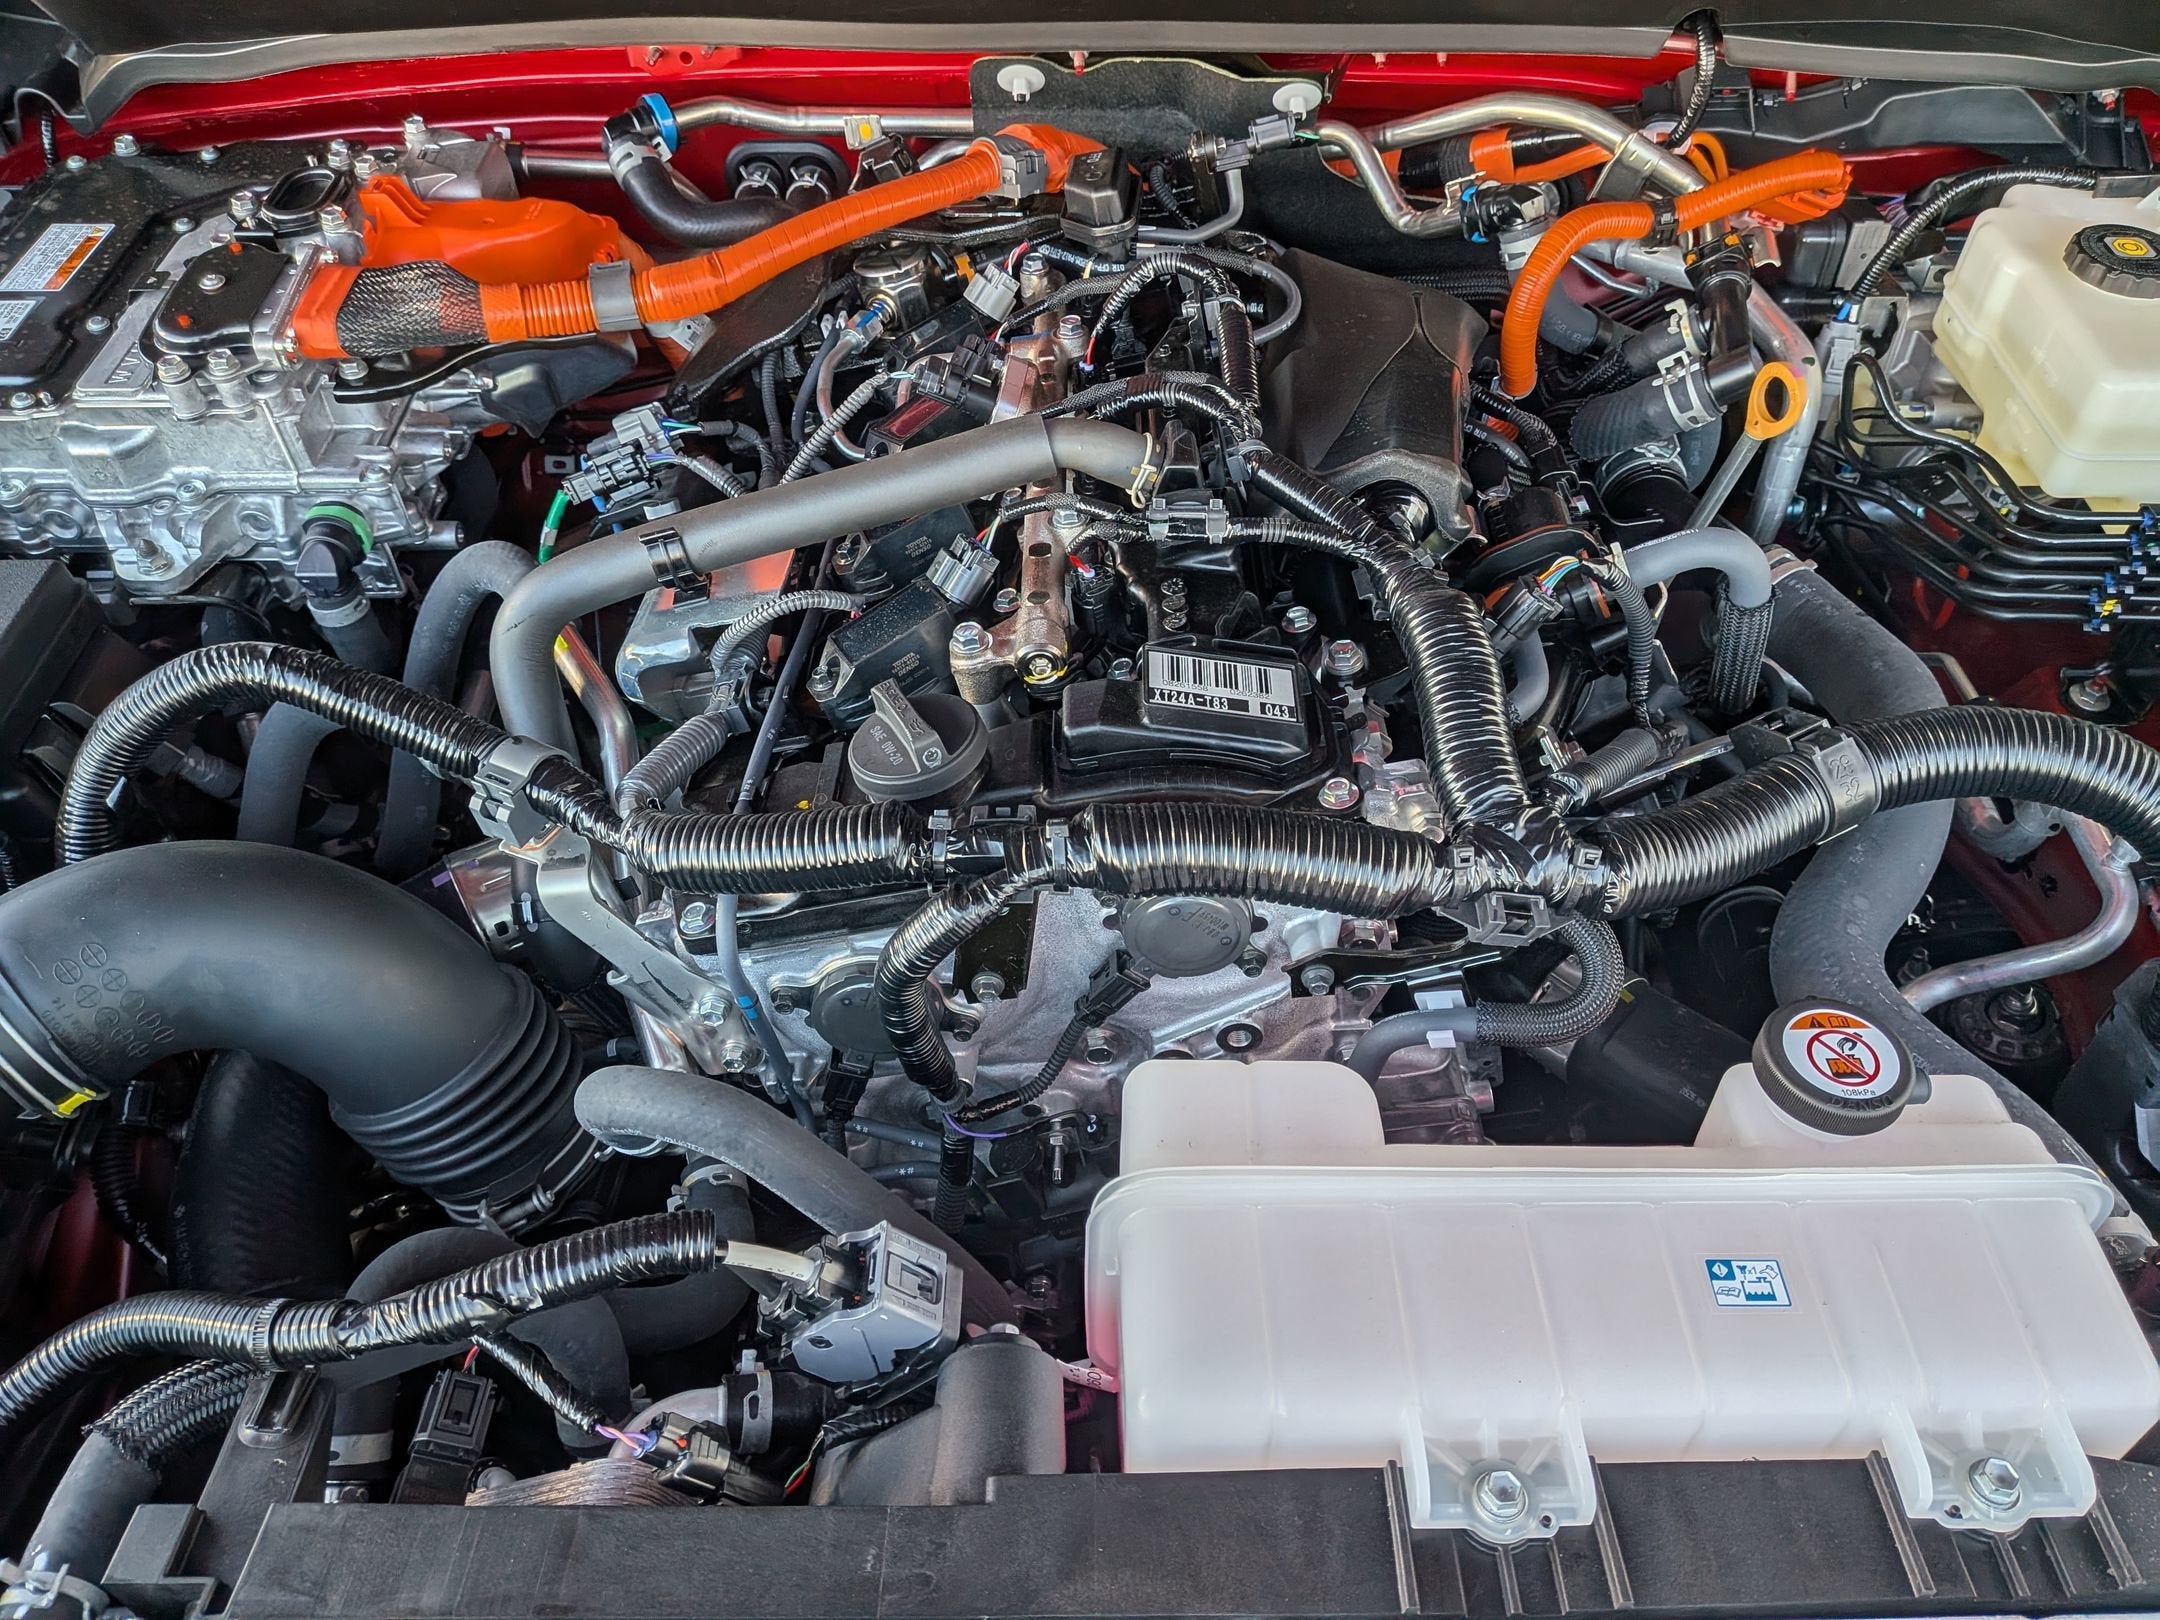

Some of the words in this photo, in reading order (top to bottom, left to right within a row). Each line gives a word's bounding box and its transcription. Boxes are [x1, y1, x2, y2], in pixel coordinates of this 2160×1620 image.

[892, 652, 916, 668] TOYOTA
[897, 660, 920, 677] DENSO
[1153, 688, 1229, 710] XT24A-T83
[1265, 703, 1290, 719] 043
[870, 725, 888, 742] SAE
[1840, 776, 1865, 806] 32
[1840, 1088, 1877, 1097] 108kPa
[1829, 1094, 1895, 1112] DENSO
